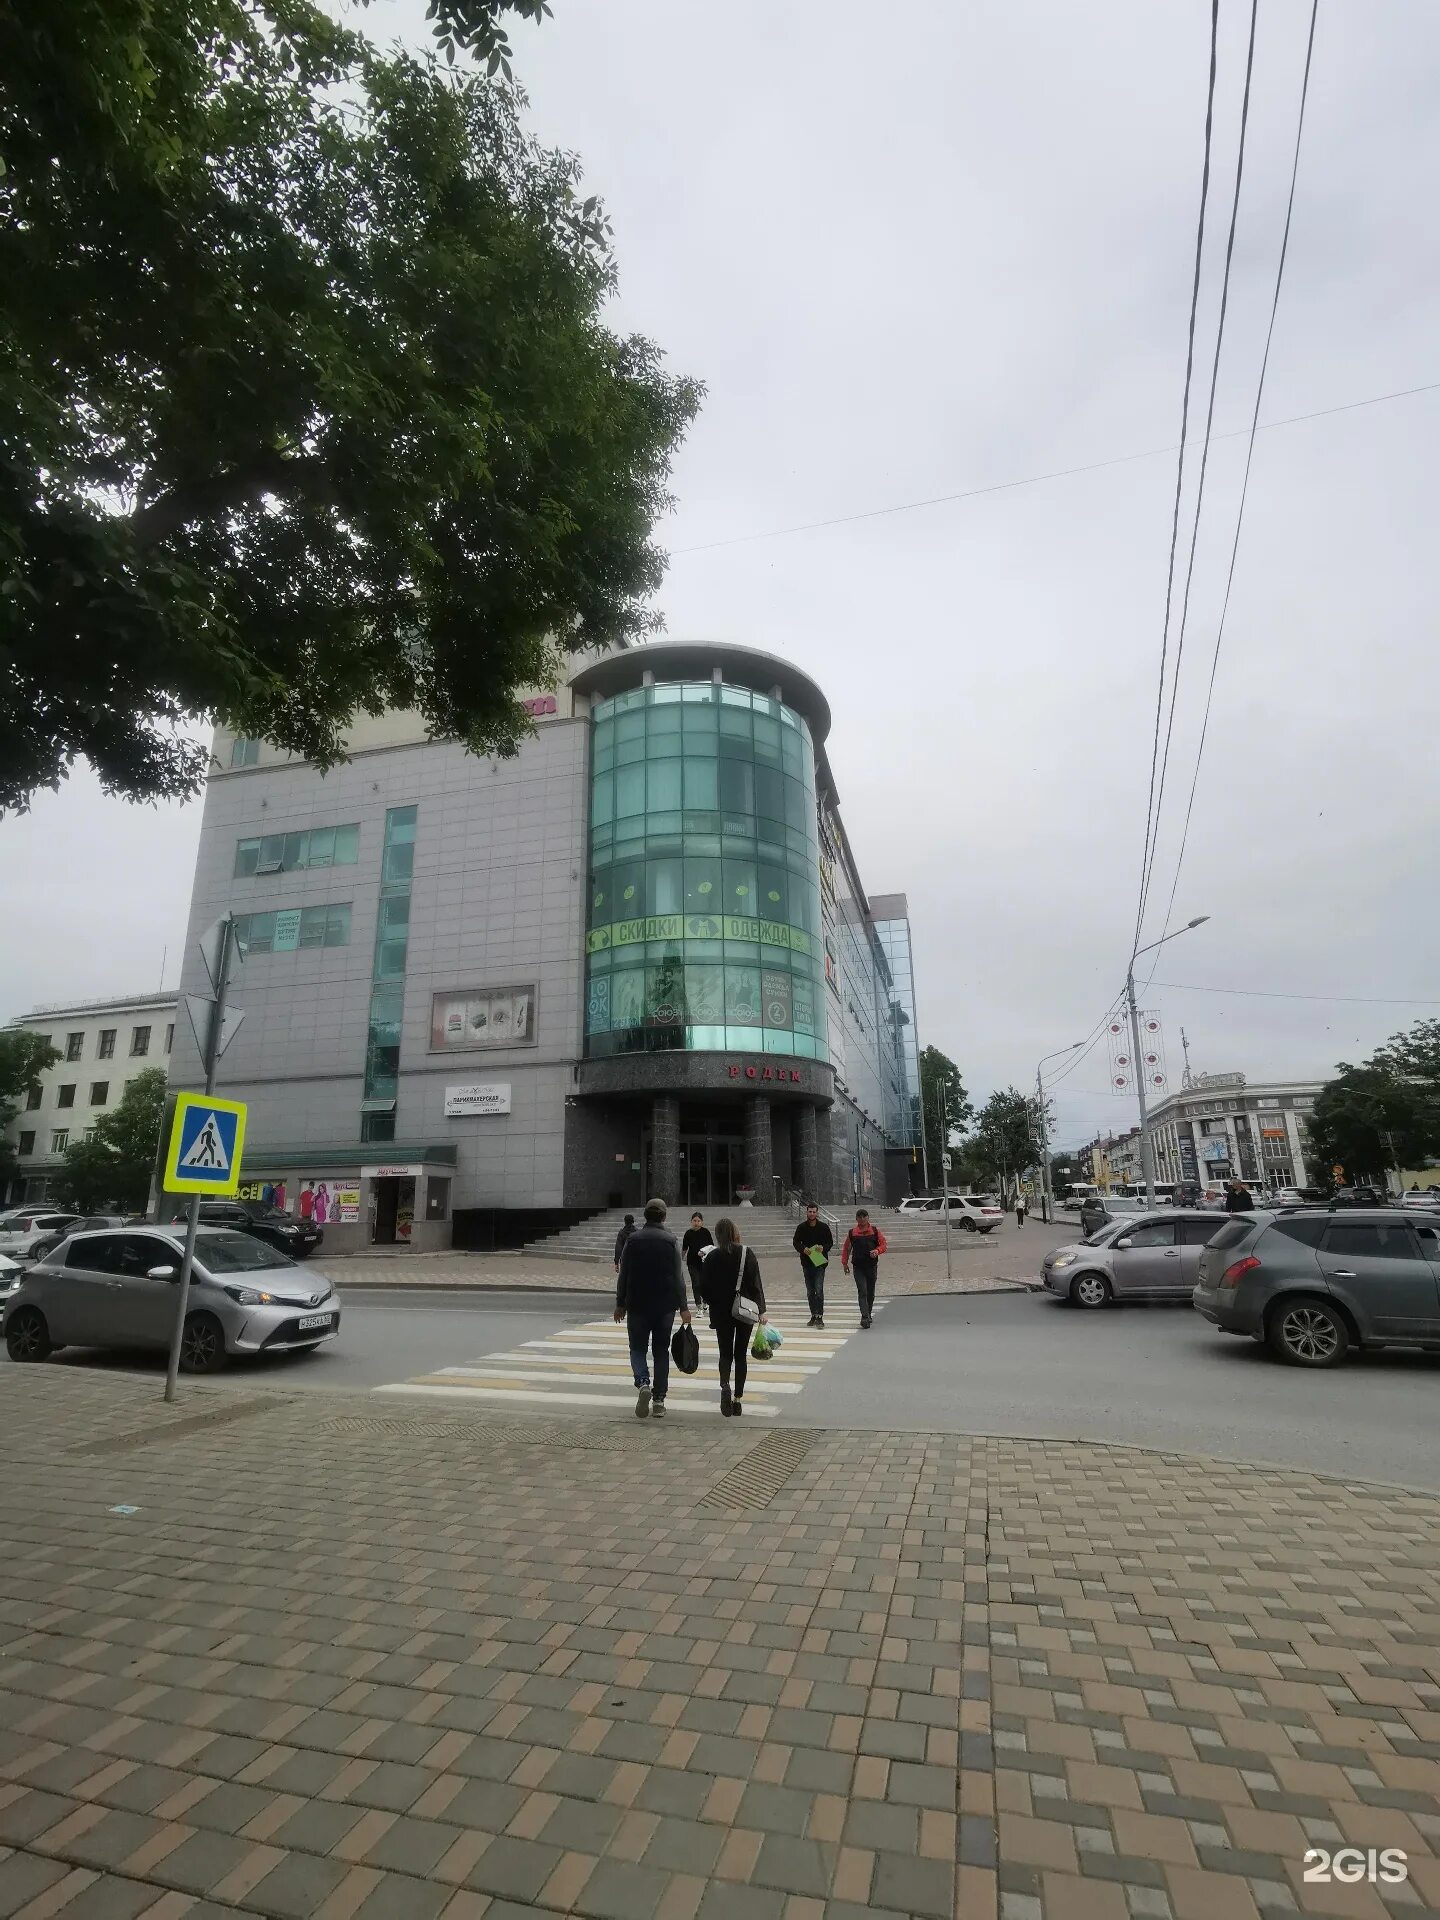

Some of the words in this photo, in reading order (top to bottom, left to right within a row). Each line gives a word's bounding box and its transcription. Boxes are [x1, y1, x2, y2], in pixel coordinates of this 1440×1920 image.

[619, 919, 677, 941] СКИДКИ
[730, 920, 789, 944] ОДЕЖДА
[231, 1184, 258, 1200] ВСЁ
